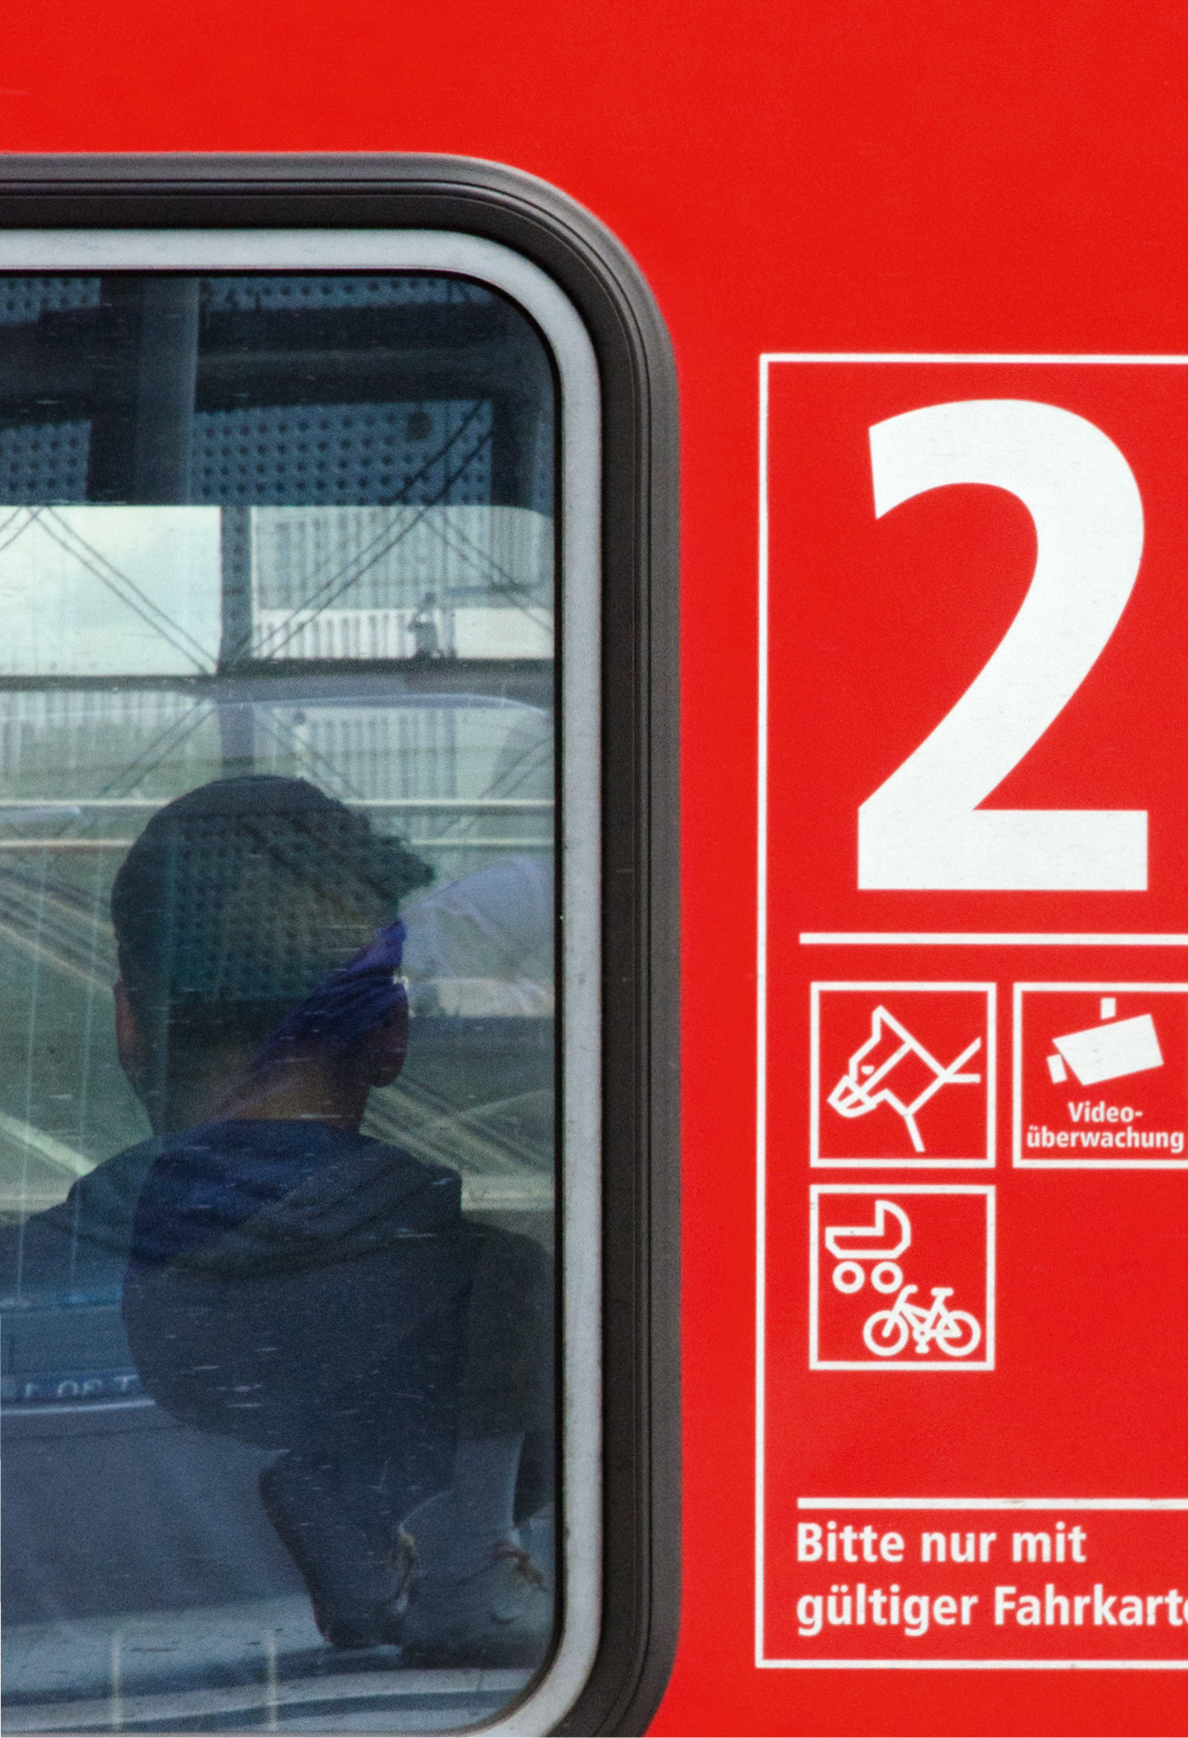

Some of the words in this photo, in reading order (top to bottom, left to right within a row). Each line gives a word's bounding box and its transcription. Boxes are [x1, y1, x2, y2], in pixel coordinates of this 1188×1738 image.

[857, 399, 1149, 892] 2
[1068, 1101, 1143, 1122] Video-
[1027, 1125, 1184, 1153] überwachung
[796, 1521, 905, 1563] Bitte
[921, 1531, 997, 1563] nur
[1012, 1520, 1087, 1563] mit
[796, 1582, 979, 1637] gültiger
